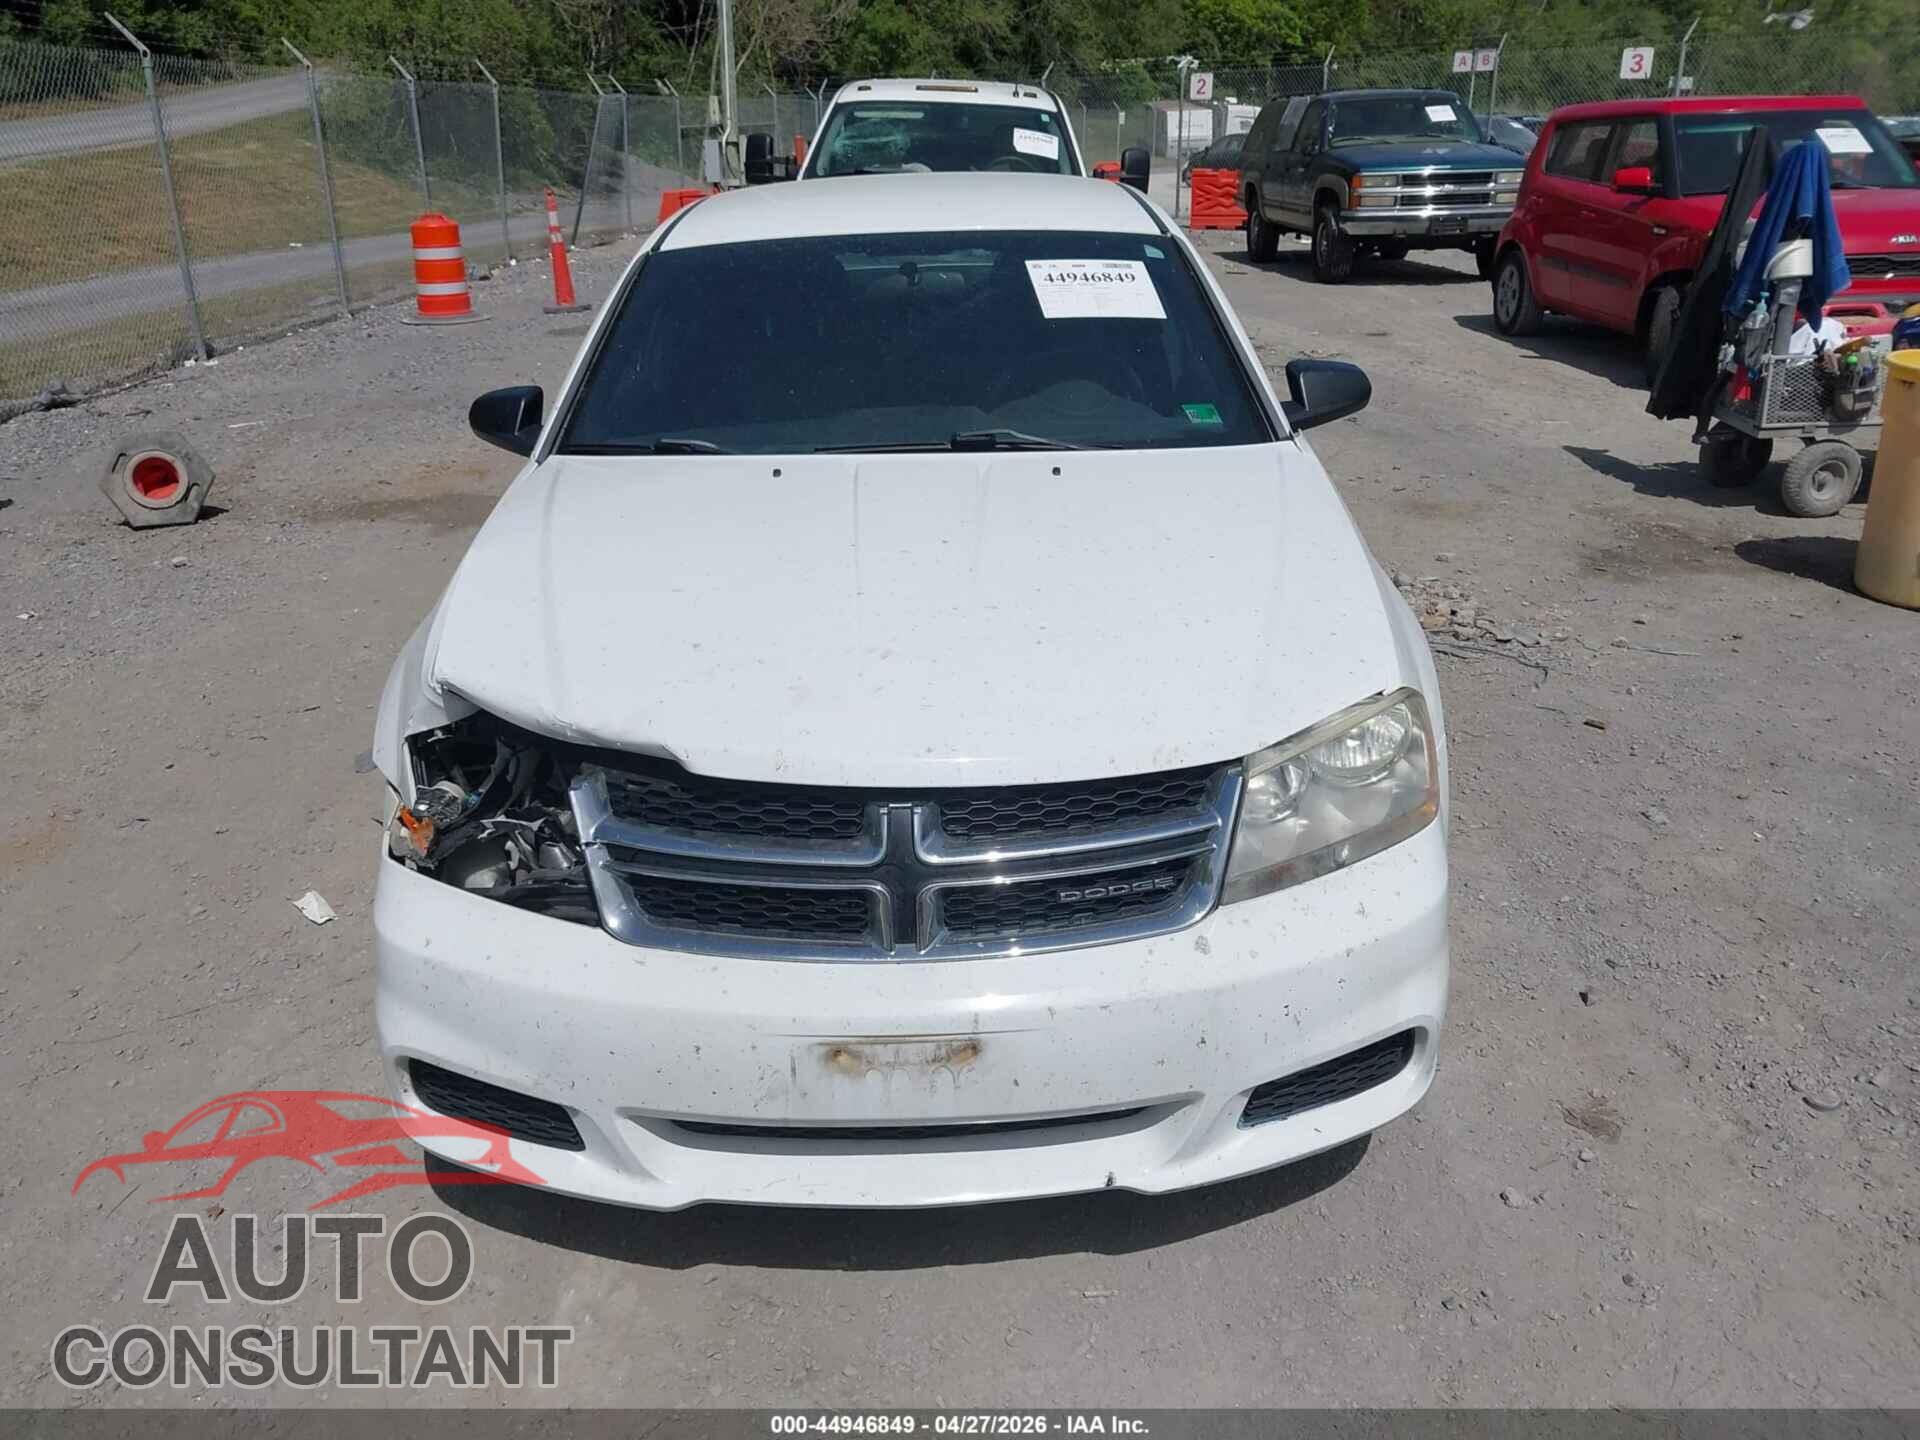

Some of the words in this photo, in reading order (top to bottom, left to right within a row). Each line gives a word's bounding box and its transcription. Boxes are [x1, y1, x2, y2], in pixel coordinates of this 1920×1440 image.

[1459, 55, 1467, 66] A
[1482, 55, 1489, 65] B
[1630, 54, 1644, 73] 3
[1197, 78, 1206, 95] 2
[1043, 272, 1136, 283] 44946849
[1060, 876, 1174, 901] DODGE
